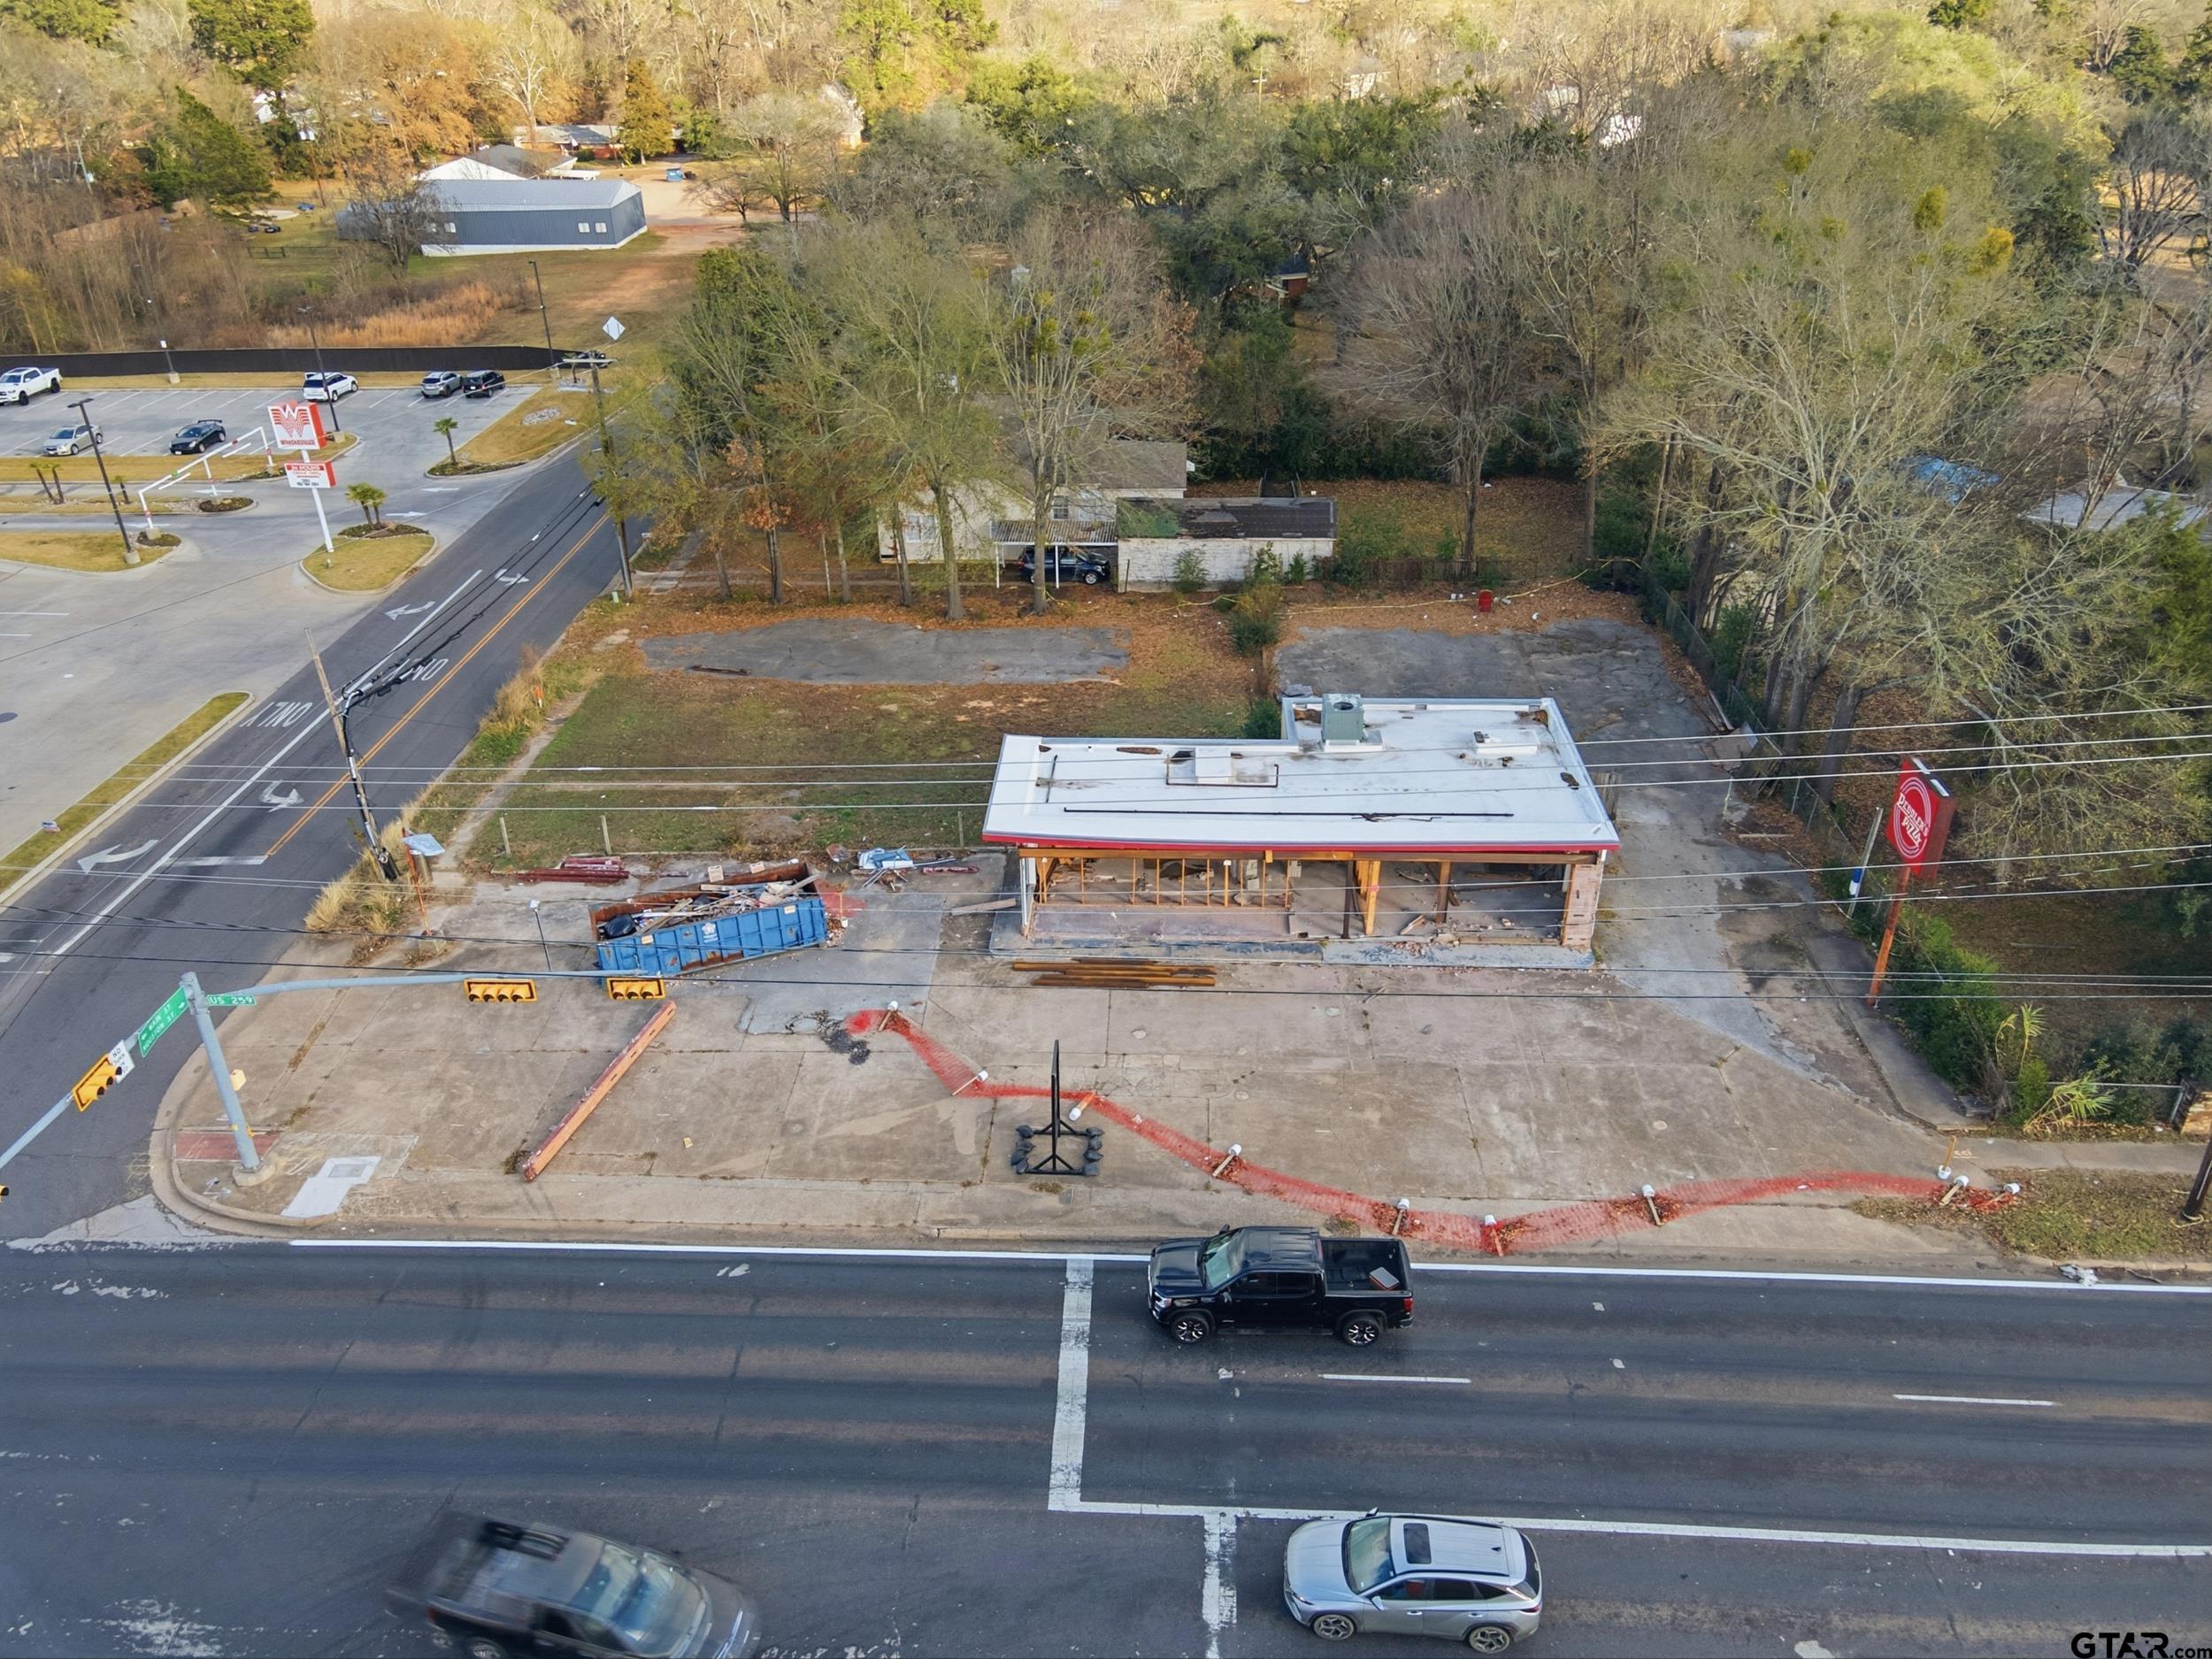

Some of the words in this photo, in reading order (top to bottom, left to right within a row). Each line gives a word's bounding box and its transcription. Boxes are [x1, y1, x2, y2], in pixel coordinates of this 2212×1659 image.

[240, 702, 313, 727] ONLY
[1897, 792, 1928, 836] PEDDLER'S
[1901, 816, 1922, 847] PIZZA
[112, 1048, 121, 1058] NO
